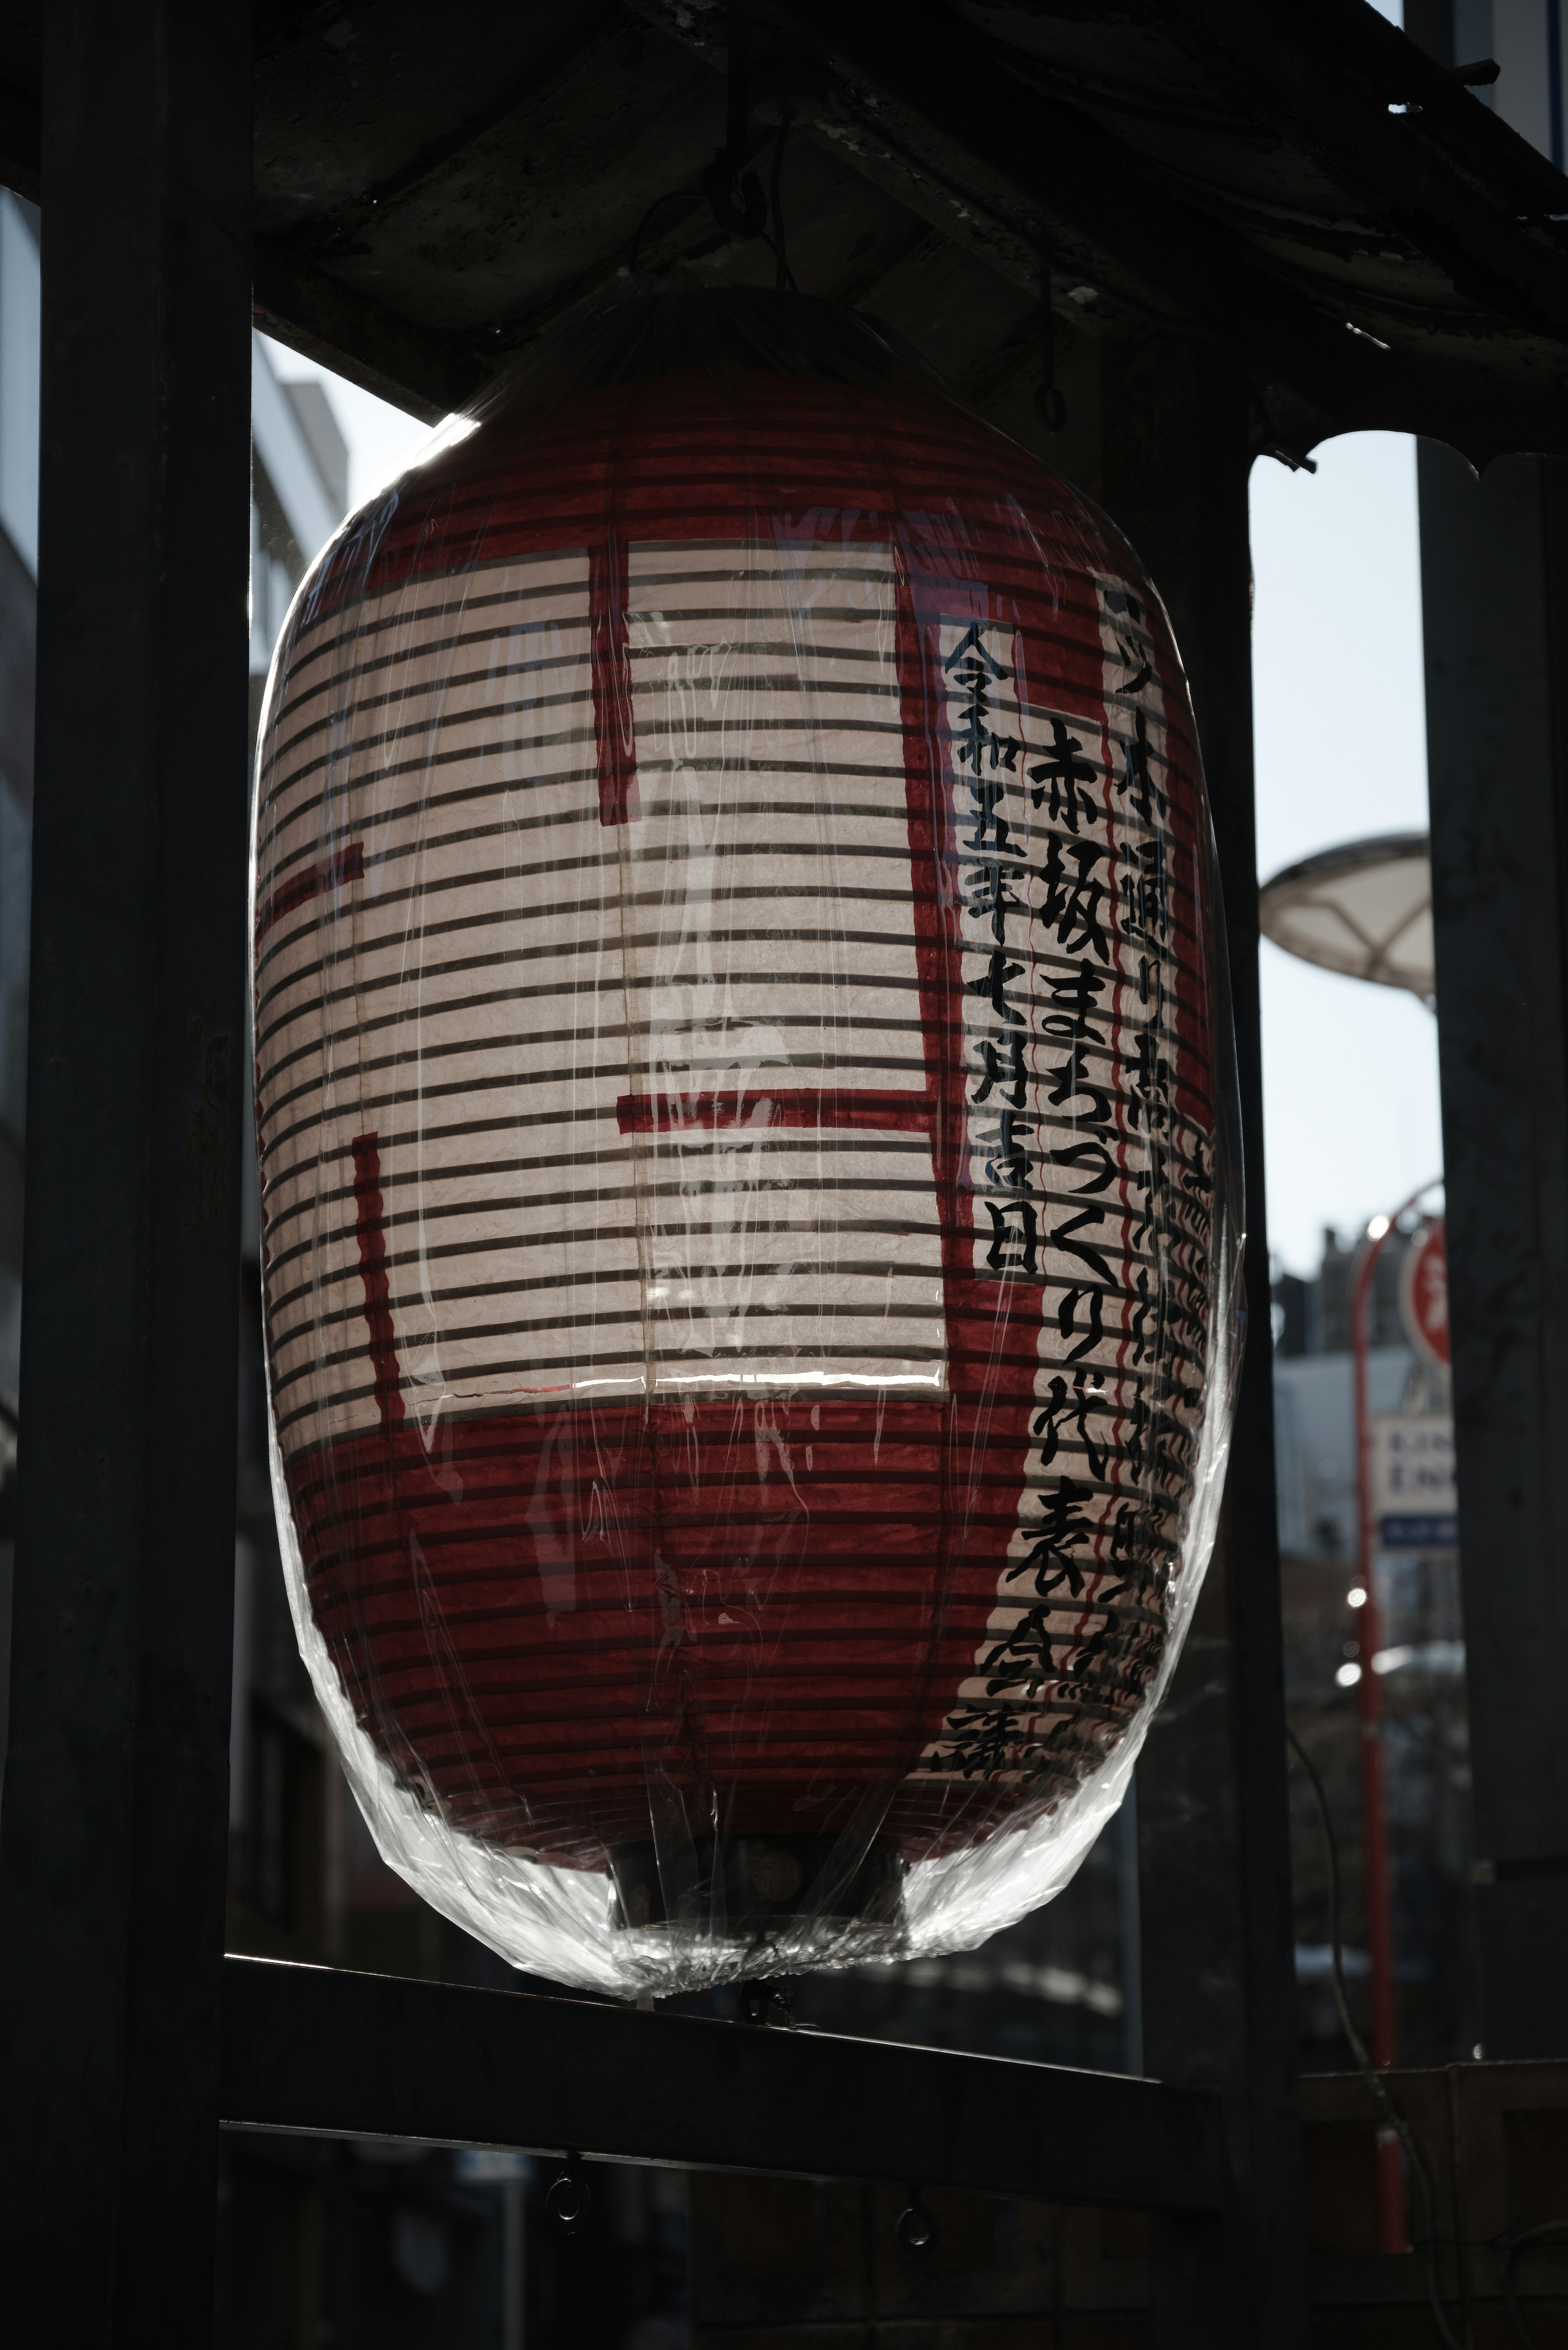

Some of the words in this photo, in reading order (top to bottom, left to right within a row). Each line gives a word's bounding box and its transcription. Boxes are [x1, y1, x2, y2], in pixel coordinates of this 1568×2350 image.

[930, 717, 1119, 1781] 赤坂まちづくり代表会議
[944, 621, 1038, 1275] 令和五年七月吉日
